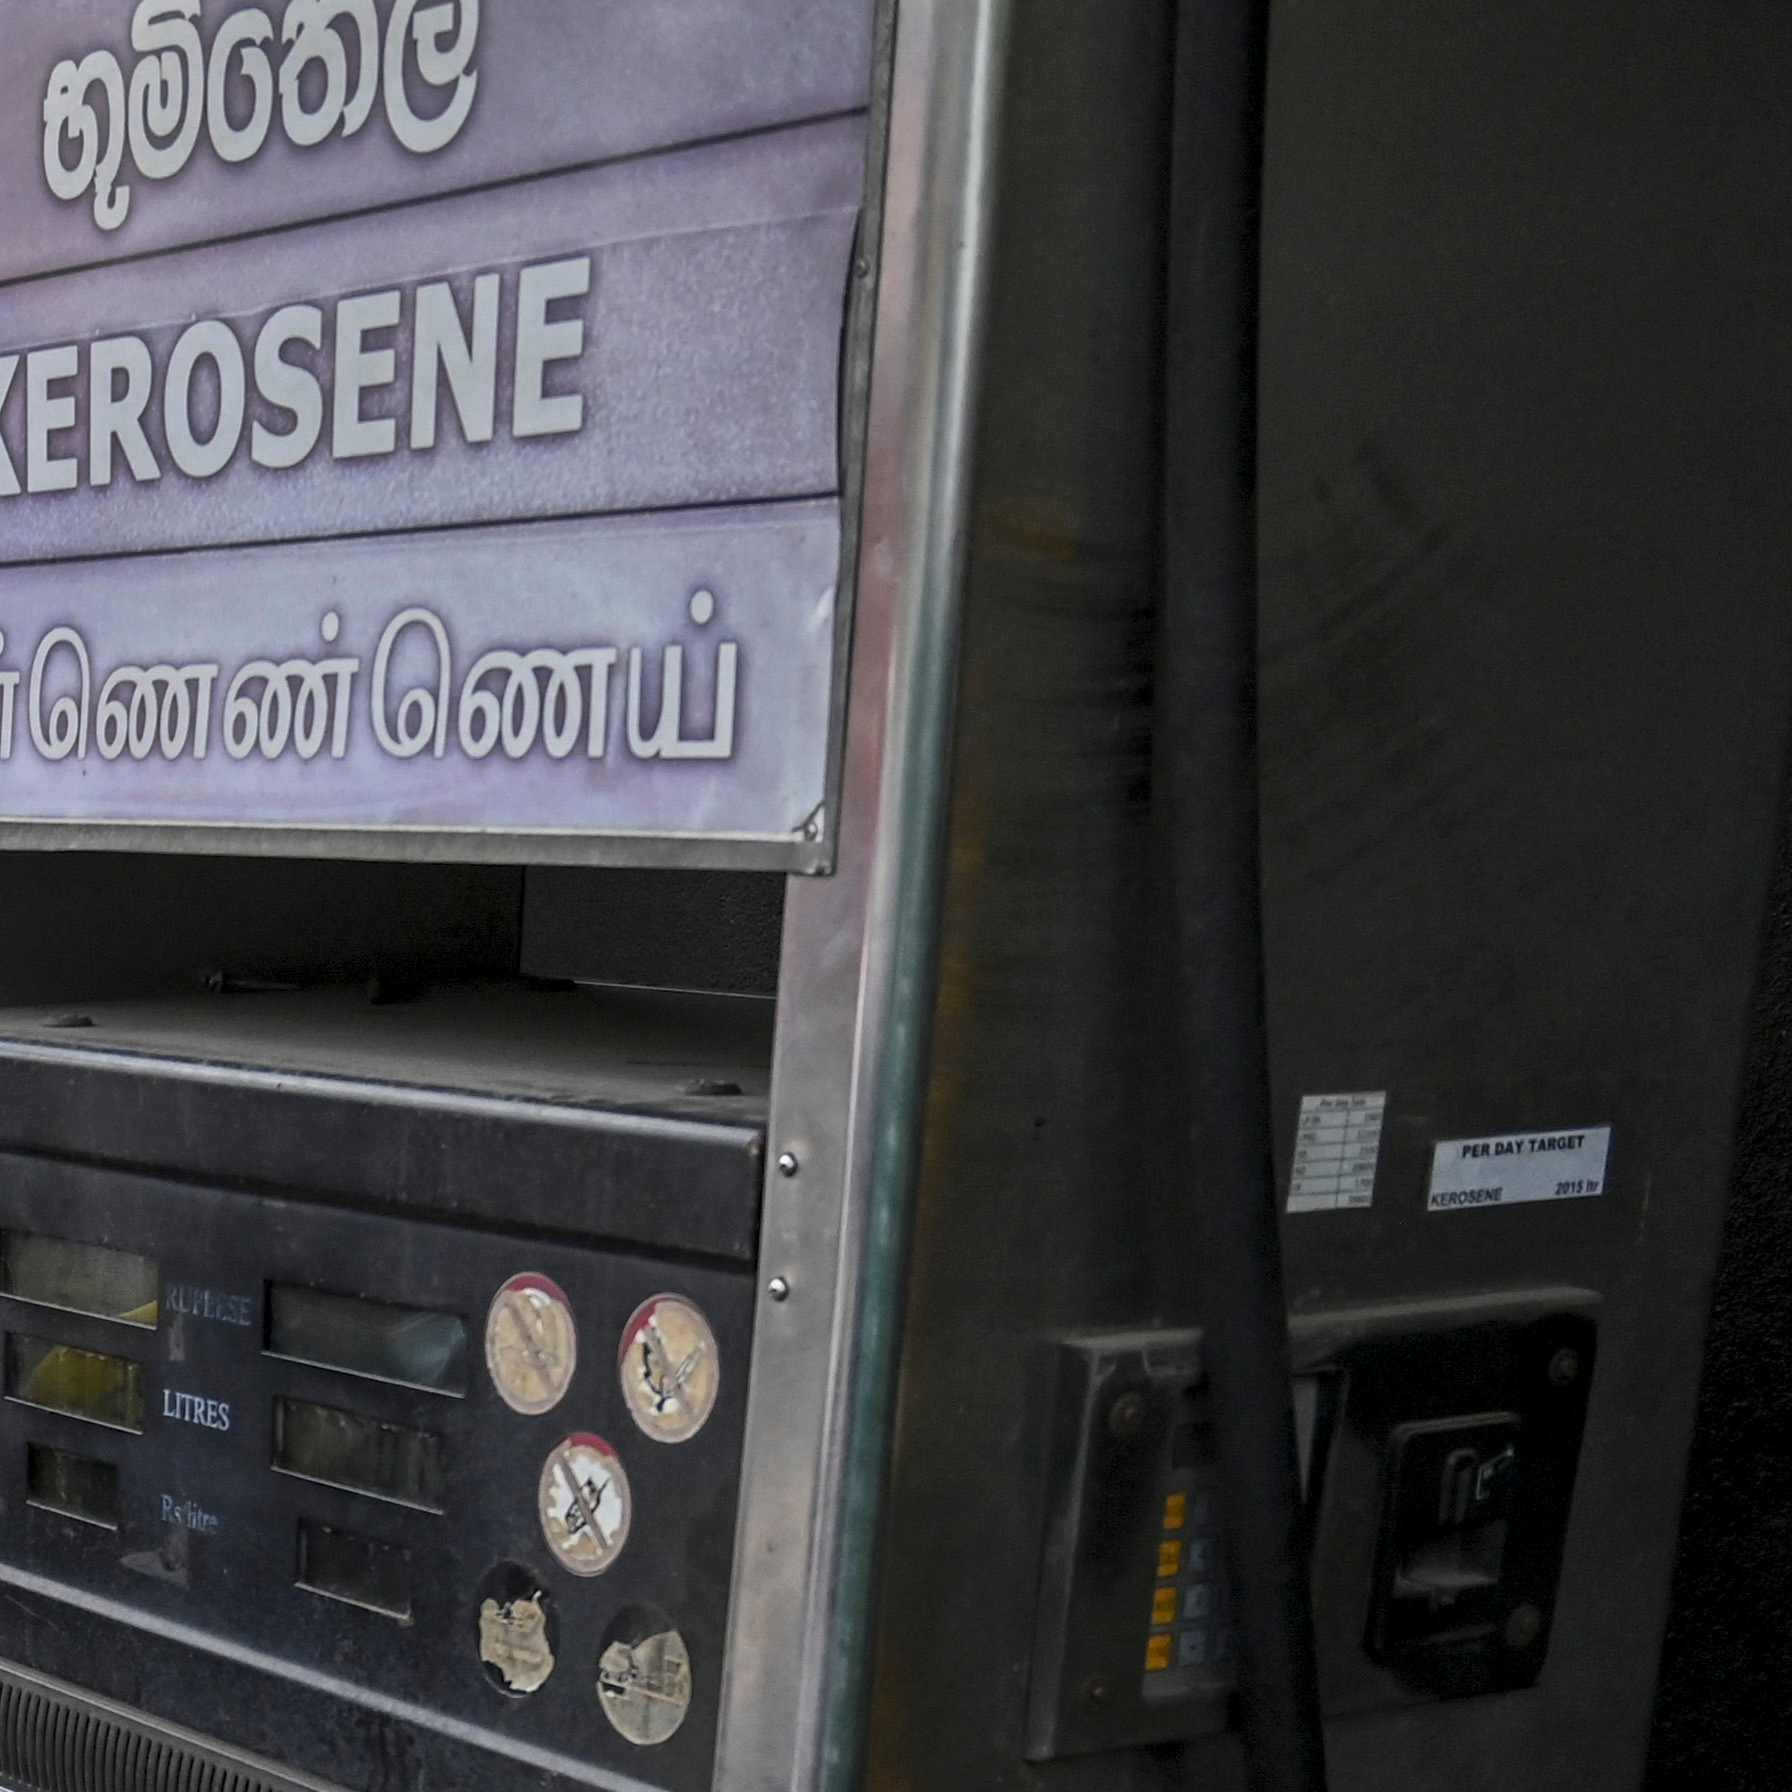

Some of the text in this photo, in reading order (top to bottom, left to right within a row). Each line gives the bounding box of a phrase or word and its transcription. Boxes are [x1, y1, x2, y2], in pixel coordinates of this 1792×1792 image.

[1461, 1135, 1586, 1159] PER DAY TARGET
[1430, 1187, 1504, 1208] KEROSENE
[162, 1388, 231, 1432] LITRES
